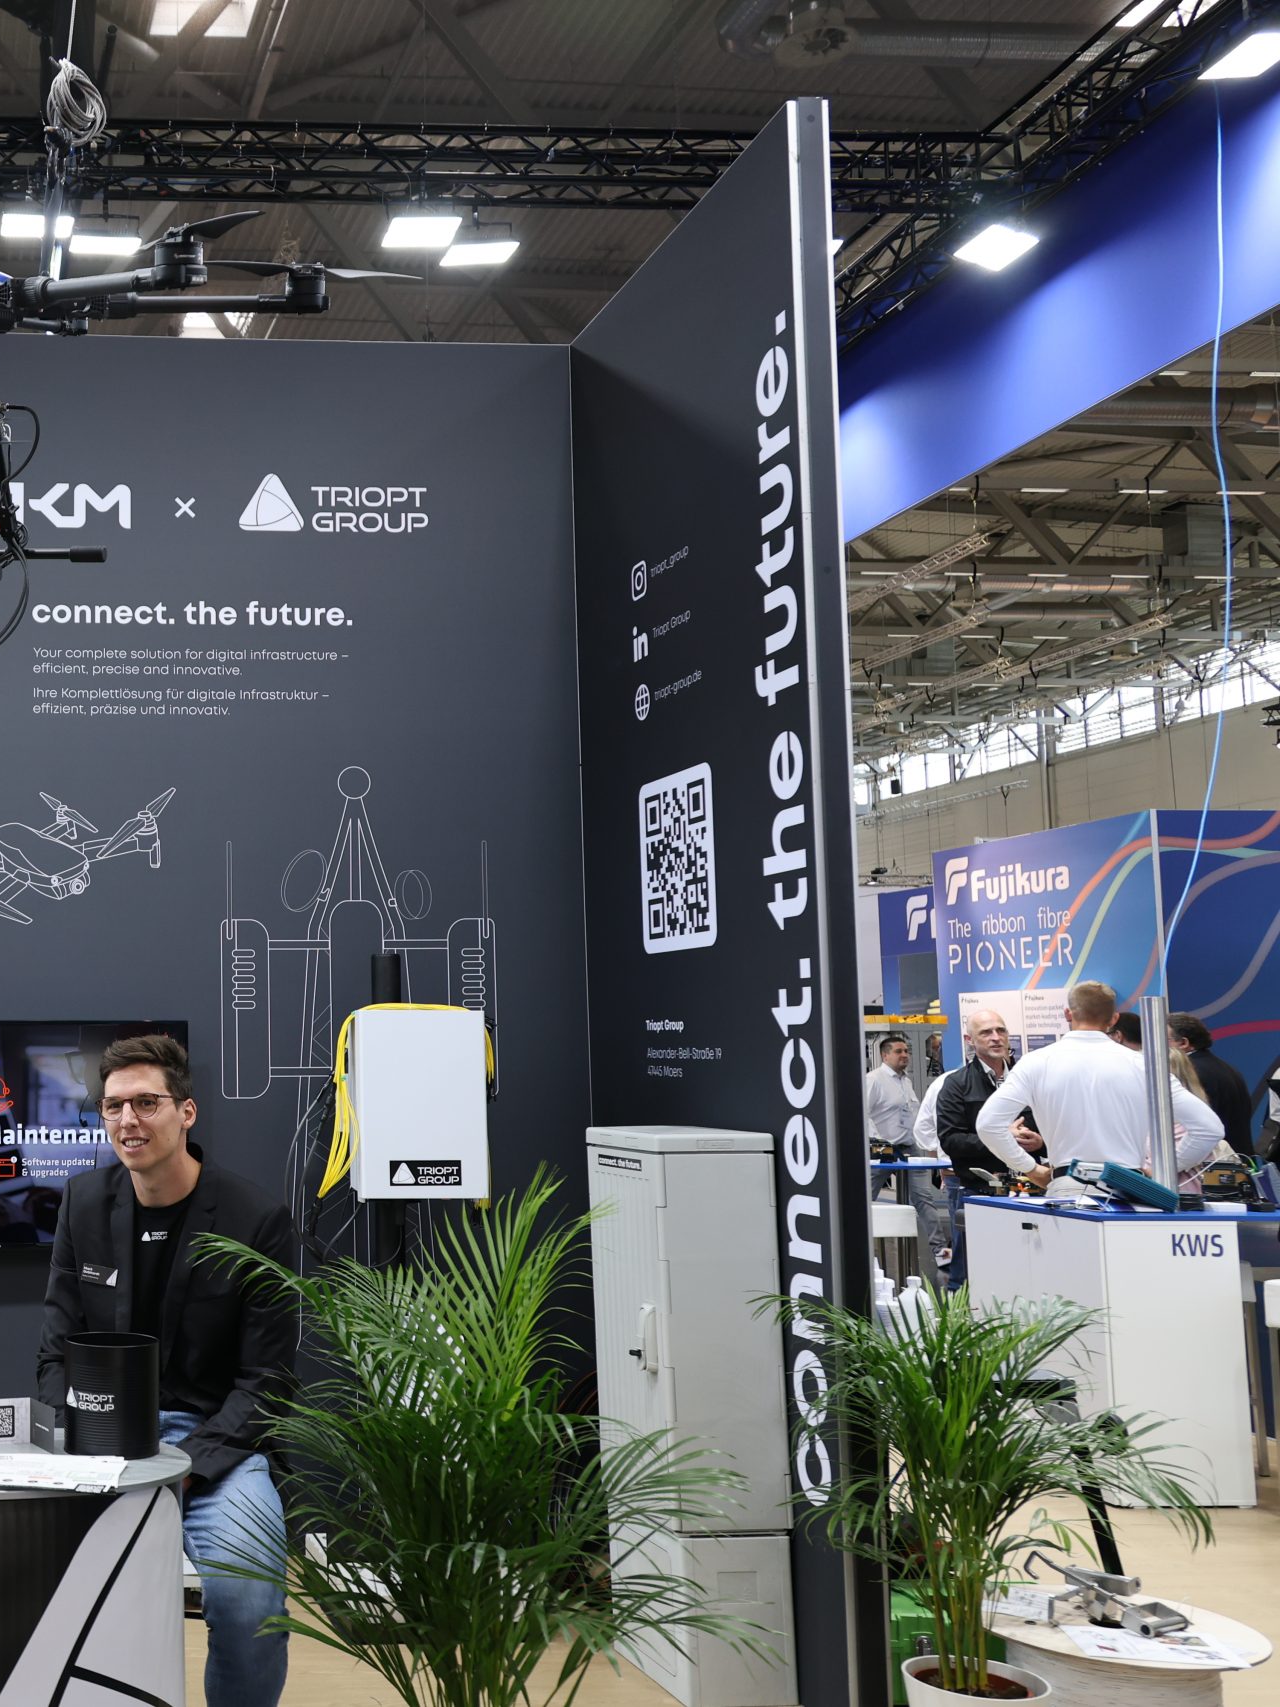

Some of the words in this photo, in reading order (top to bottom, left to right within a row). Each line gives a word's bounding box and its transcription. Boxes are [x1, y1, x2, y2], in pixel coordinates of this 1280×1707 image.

[311, 486, 427, 507] TRIOPT
[754, 309, 799, 707] future.
[312, 512, 429, 533] GROUP
[650, 545, 689, 578] triopt_group
[32, 601, 175, 625] connect.
[184, 601, 237, 625] the
[246, 601, 353, 626] future.
[670, 610, 691, 629] Group
[33, 648, 62, 659] Your
[65, 648, 127, 661] complete
[131, 648, 181, 660] solution
[185, 649, 203, 660] for
[206, 649, 246, 662] digital
[250, 649, 337, 660] infrastructure
[33, 662, 89, 675] efficient,
[92, 664, 140, 676] precise
[143, 664, 169, 675] and
[173, 664, 242, 676] innovative.
[33, 687, 57, 698] Ihre
[61, 687, 162, 701] Komplettlösung
[166, 688, 185, 699] für
[187, 689, 236, 702] digitale
[240, 689, 318, 700] Infrastruktur
[654, 669, 702, 701] triopt-group.de
[33, 703, 87, 715] effizient,
[90, 703, 137, 716] präzise
[140, 704, 165, 715] und
[170, 704, 230, 716] innovativ.
[762, 730, 809, 931] the
[971, 863, 1069, 904] Fujikura
[948, 918, 972, 940] The
[982, 912, 1026, 936] ribbon
[1037, 906, 1071, 929] fibre
[948, 933, 1074, 974] PIONEER
[646, 1019, 664, 1033] Triopt
[664, 1019, 684, 1033] Group
[663, 1065, 683, 1077] Moers
[22, 1157, 59, 1167] Software
[62, 1158, 95, 1169] updates
[417, 1166, 459, 1175] TRIOPT
[22, 1169, 28, 1177] &
[30, 1168, 69, 1179] upgrades
[417, 1176, 460, 1184] GROUP
[771, 958, 831, 1507] connect.
[1172, 1233, 1224, 1257] KWS
[78, 1392, 115, 1403] TRIOPT
[78, 1401, 115, 1412] GROUP
